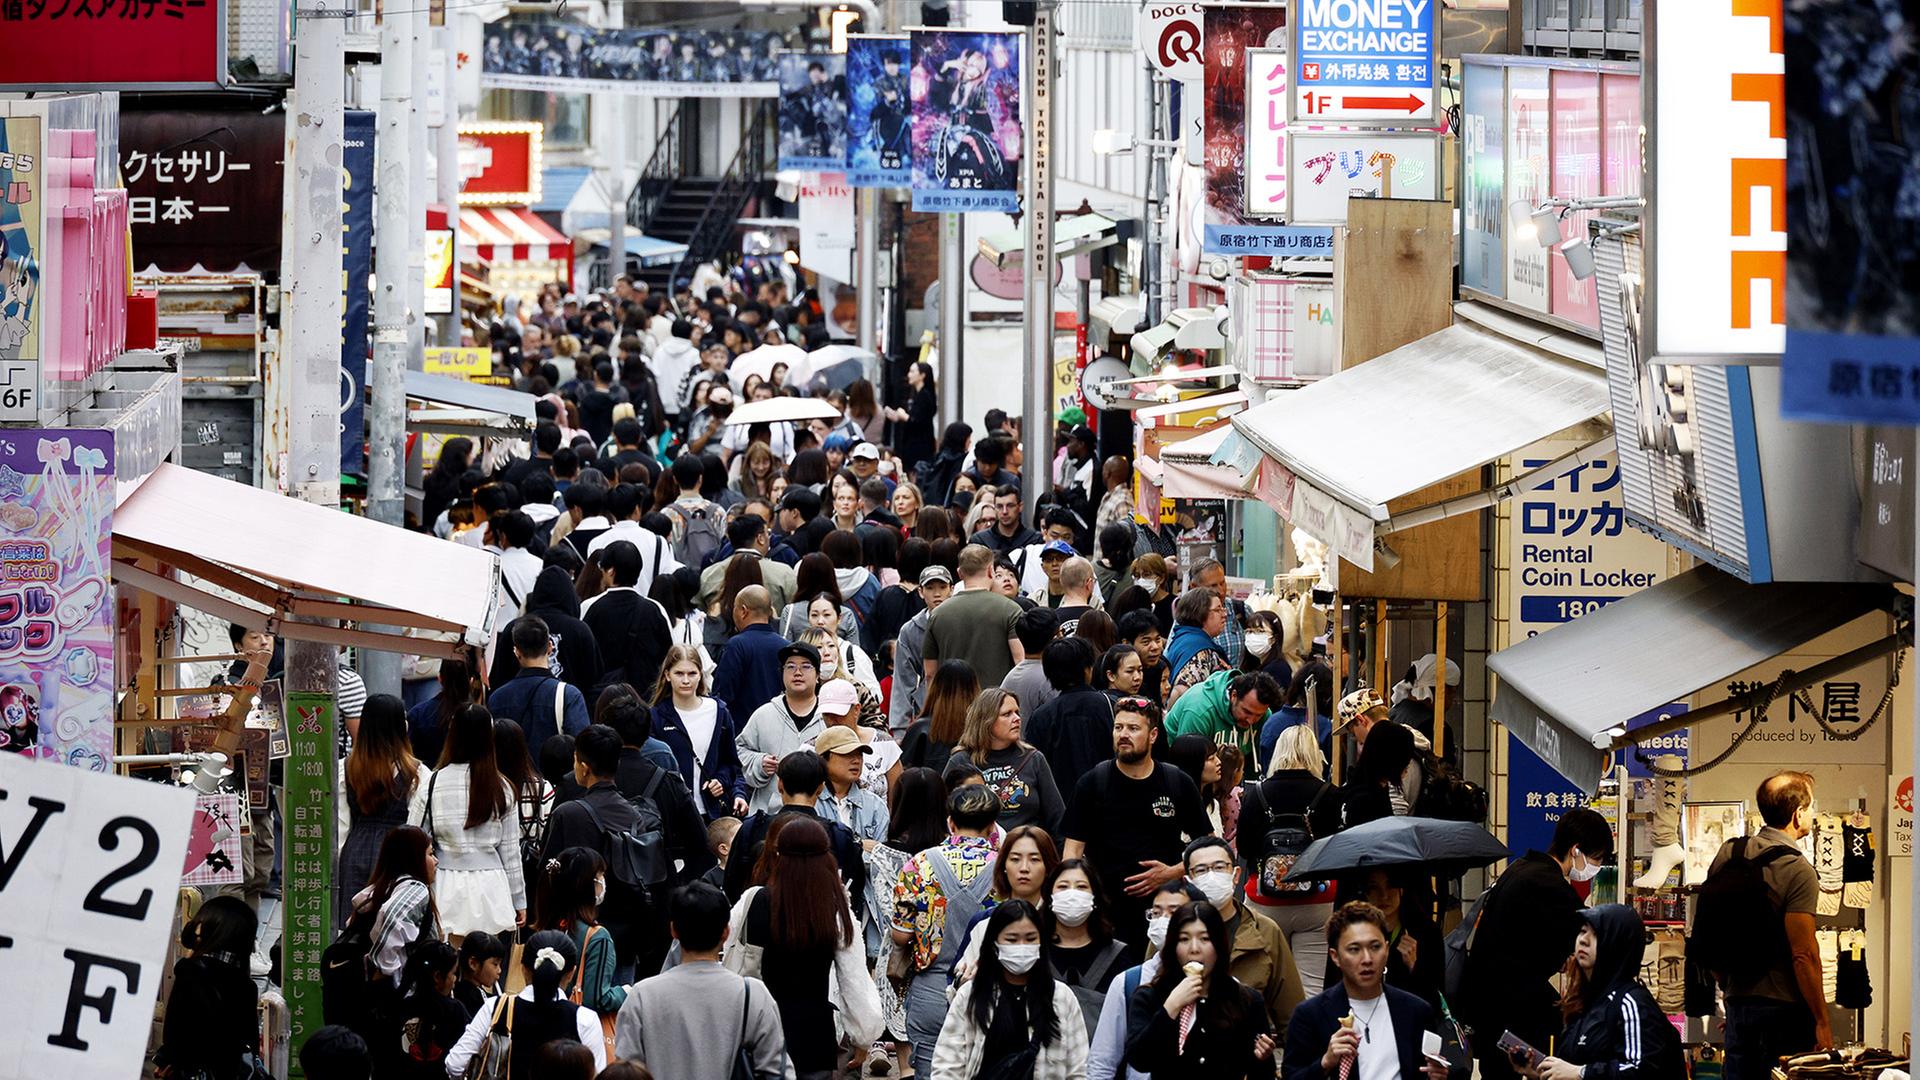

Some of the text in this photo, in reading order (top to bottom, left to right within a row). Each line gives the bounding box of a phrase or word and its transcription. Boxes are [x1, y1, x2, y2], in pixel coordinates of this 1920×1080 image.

[1152, 5, 1186, 19] DOG
[1303, 0, 1427, 29] MONEY
[1303, 31, 1427, 52] EXCHANGE
[1395, 64, 1426, 81] 환전
[1303, 92, 1331, 114] 1F
[1036, 110, 1045, 199] TAKESHITA
[950, 178, 983, 189] あまと
[129, 197, 230, 225] 日本一
[1036, 212, 1044, 271] Street
[1523, 544, 1593, 563] Rental
[1522, 567, 1656, 587] Coin Locker
[1799, 729, 1817, 745] by
[296, 742, 316, 756] 11:00
[1545, 813, 1561, 822] No
[307, 788, 323, 982] 竹下通りは歩行者用道路
[292, 807, 308, 1035] 自転車は押して歩きましょう
